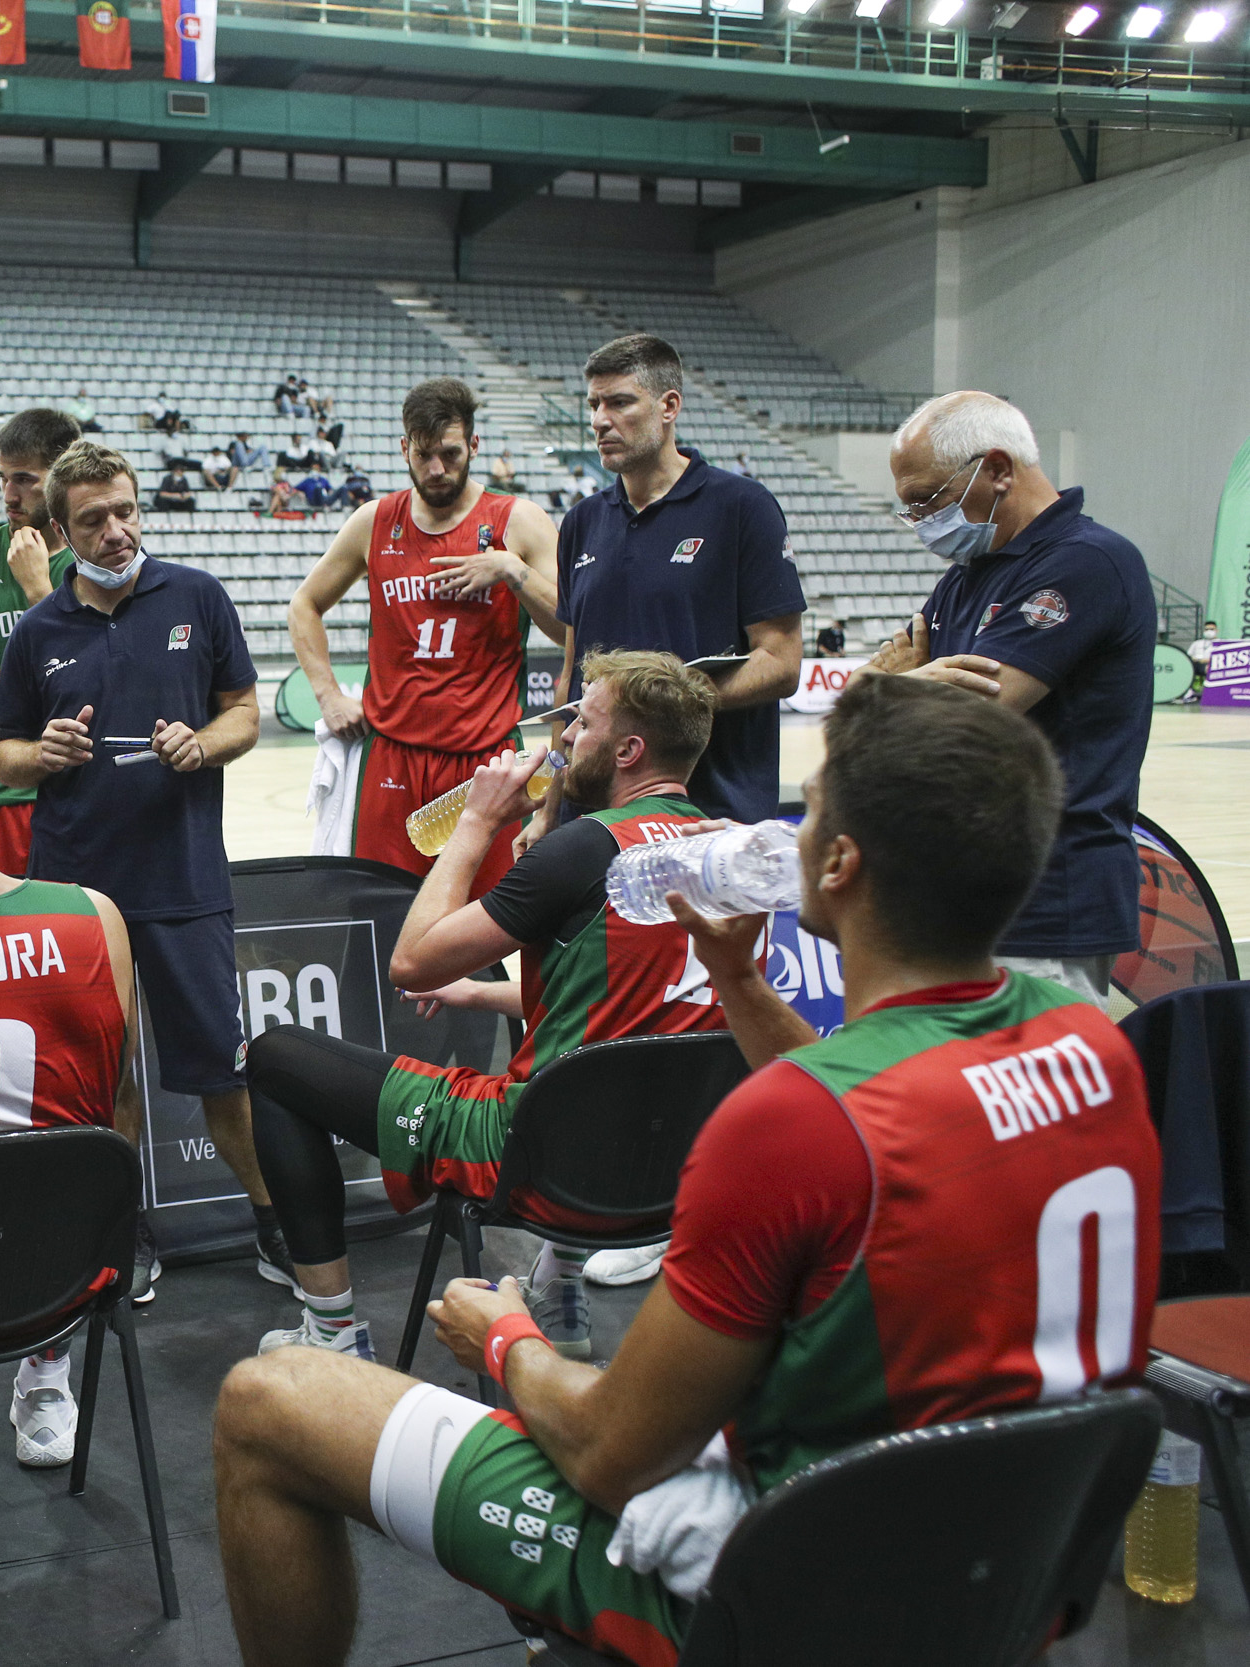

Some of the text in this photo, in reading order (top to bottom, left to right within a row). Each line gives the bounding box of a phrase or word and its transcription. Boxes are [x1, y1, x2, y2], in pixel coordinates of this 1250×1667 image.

[413, 617, 458, 659] 11
[45, 656, 78, 677] DHIKA
[1211, 649, 1250, 672] RES
[961, 1033, 1113, 1142] BRITO
[179, 1137, 217, 1162] We
[1033, 1165, 1137, 1401] 0
